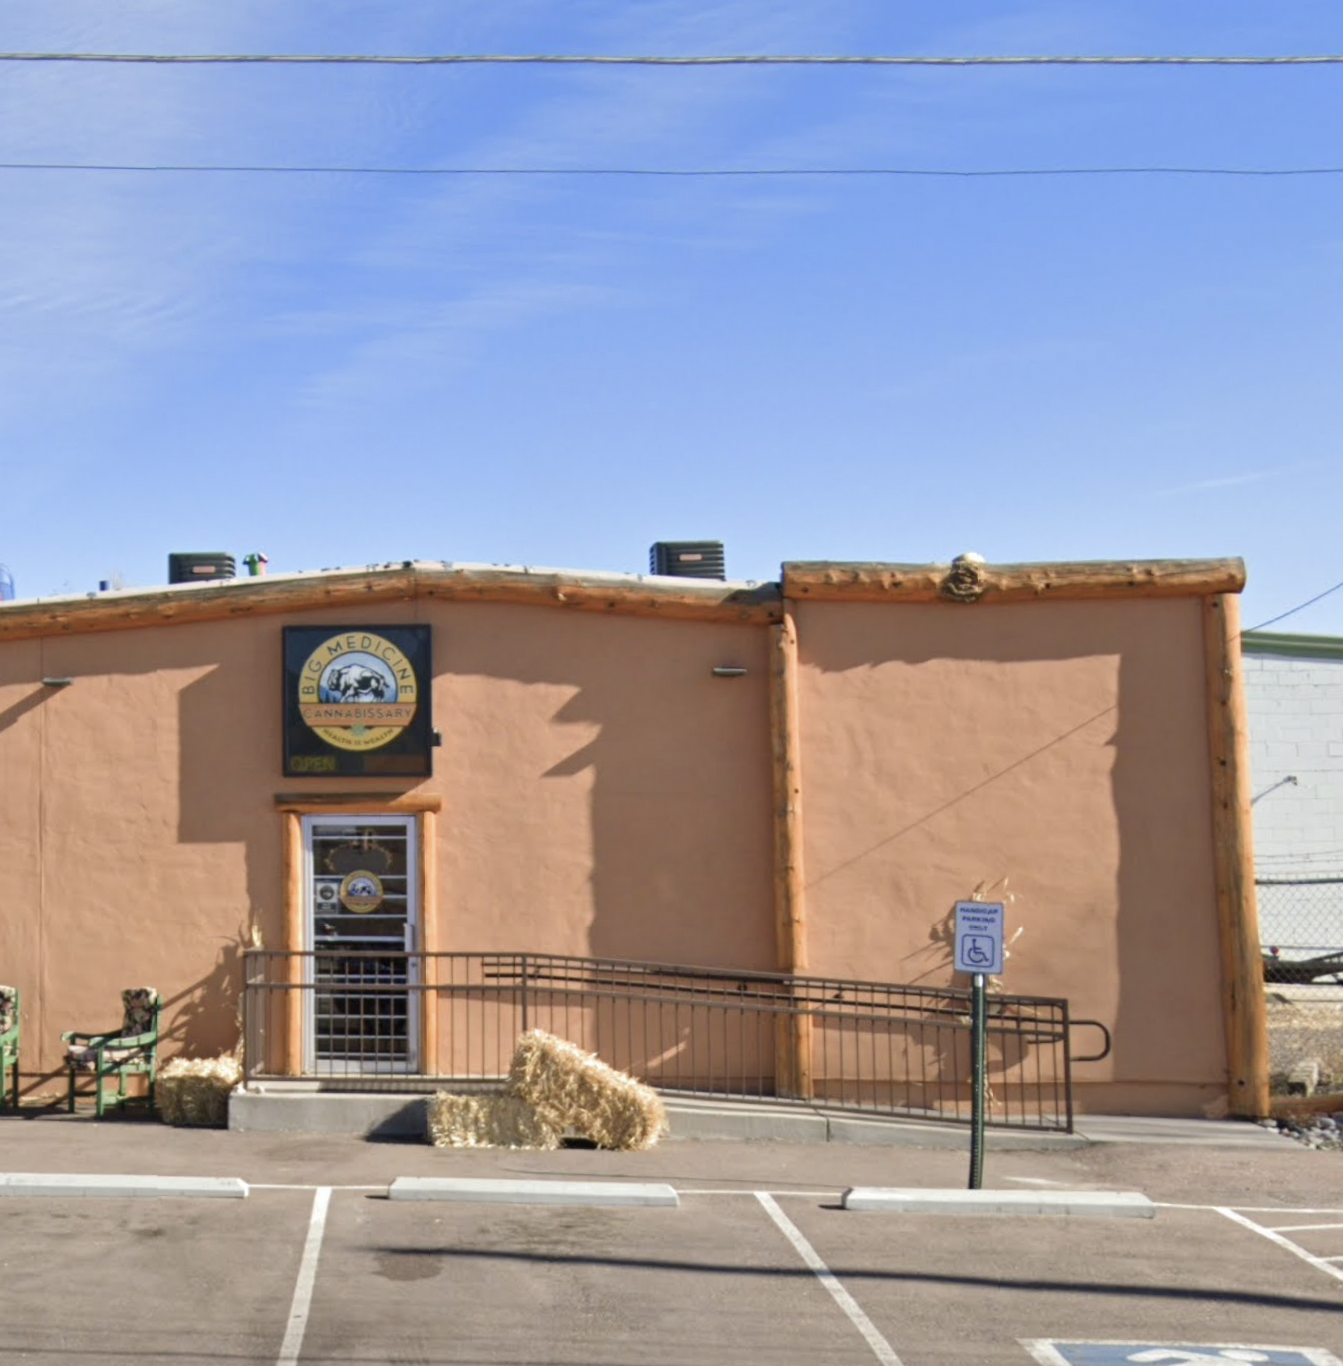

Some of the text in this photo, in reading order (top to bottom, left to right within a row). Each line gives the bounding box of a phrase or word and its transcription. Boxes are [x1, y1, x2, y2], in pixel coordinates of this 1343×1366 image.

[302, 636, 413, 694] BIG MEDICINE
[303, 708, 412, 719] CANNABISSARY
[291, 756, 335, 771] OPEN
